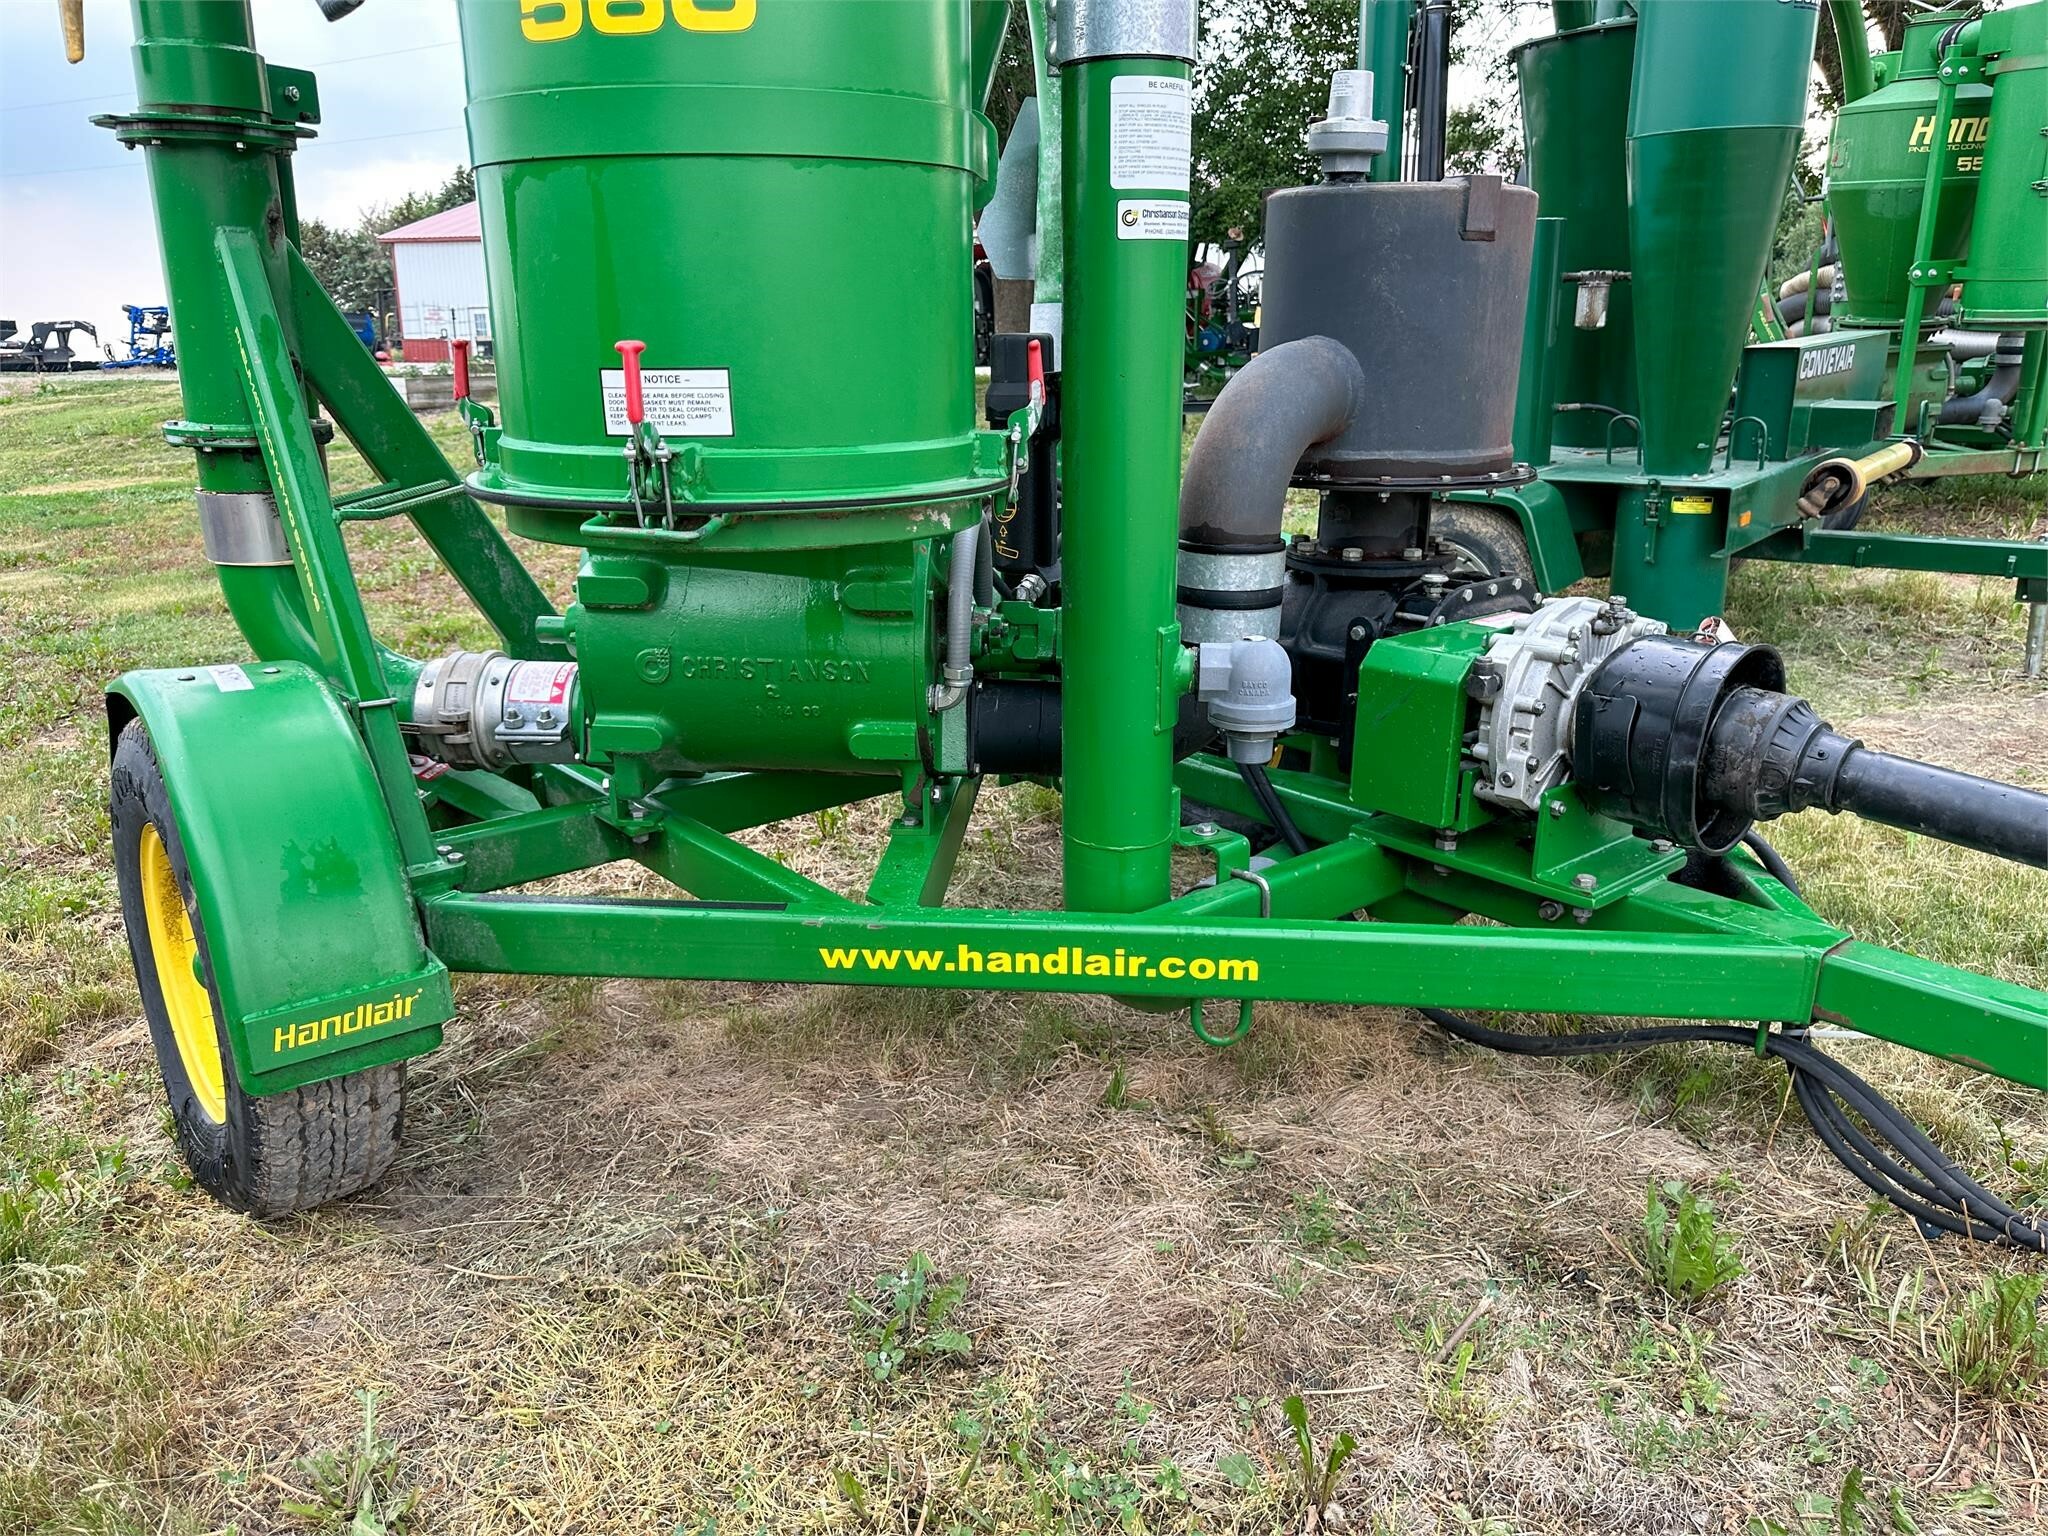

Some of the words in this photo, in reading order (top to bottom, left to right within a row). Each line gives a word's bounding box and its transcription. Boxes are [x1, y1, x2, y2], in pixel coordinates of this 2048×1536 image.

[1159, 81, 1185, 91] CAREFUL
[1800, 343, 1856, 380] CONVEYAIR
[644, 374, 681, 384] NOTICE
[294, 528, 320, 613] SYSTEMS
[682, 656, 871, 683] CHRISTIANSON
[1239, 689, 1271, 697] CANADA
[819, 944, 1259, 981] www.handlair.com
[273, 992, 420, 1053] Handlair
